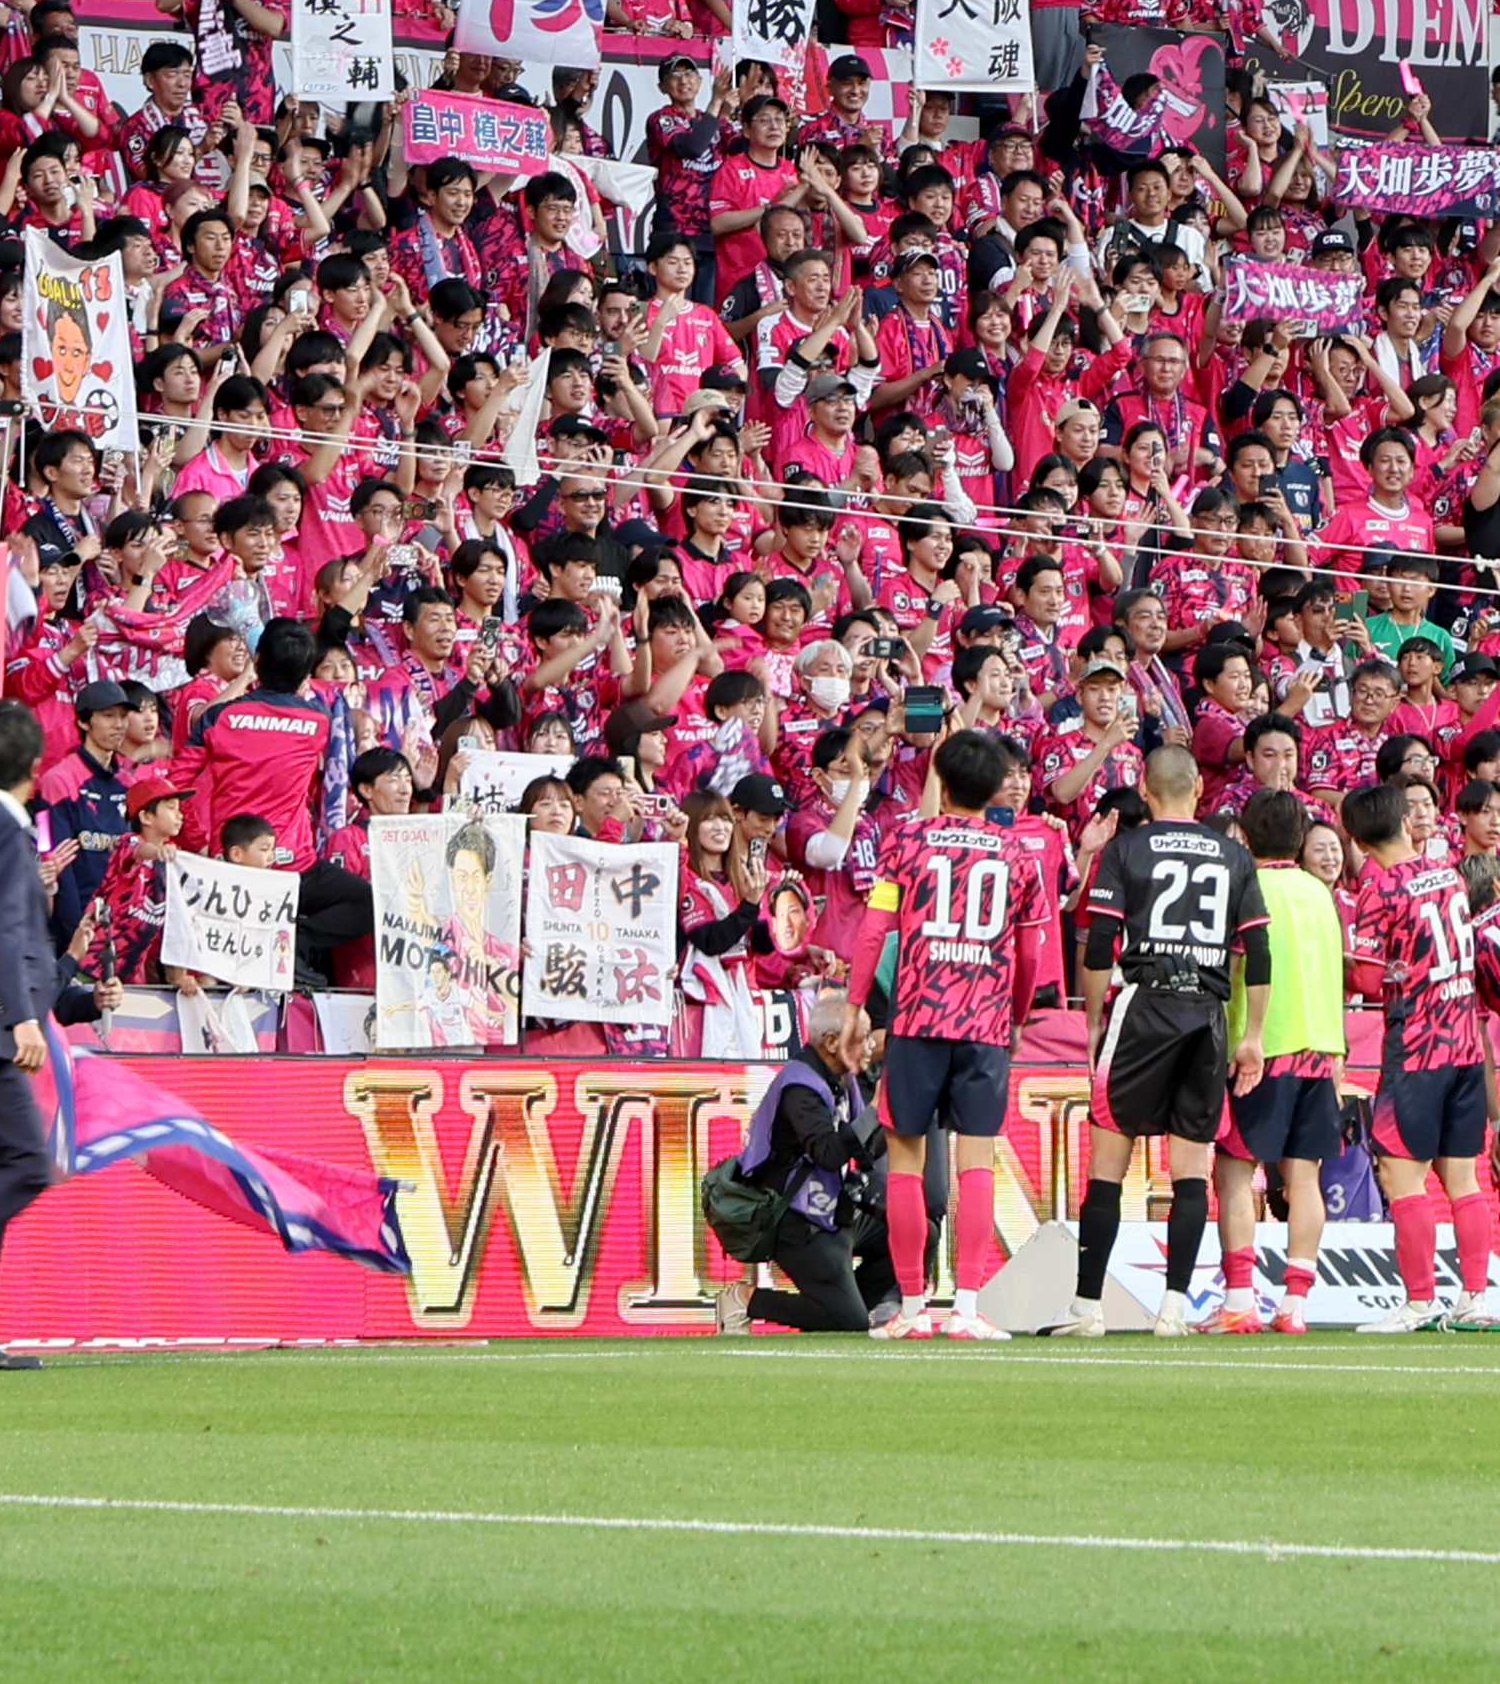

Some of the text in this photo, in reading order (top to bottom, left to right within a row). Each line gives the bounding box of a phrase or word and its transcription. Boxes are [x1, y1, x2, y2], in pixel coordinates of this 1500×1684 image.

[988, 39, 1022, 81] 魂
[410, 101, 466, 147] 畠中
[1322, 235, 1344, 249] CRZ
[81, 266, 113, 303] 13
[227, 713, 319, 737] YANMAR
[380, 828, 400, 843] GET
[929, 832, 999, 849] シャウエッセン
[1153, 837, 1221, 855] シャウエッセン
[921, 853, 1009, 941] 10
[1149, 861, 1231, 945] 23
[381, 912, 456, 945] NAKAJIMA
[542, 919, 661, 942] SHUNTA 10 TANAKA
[929, 942, 993, 967] SHUNTA
